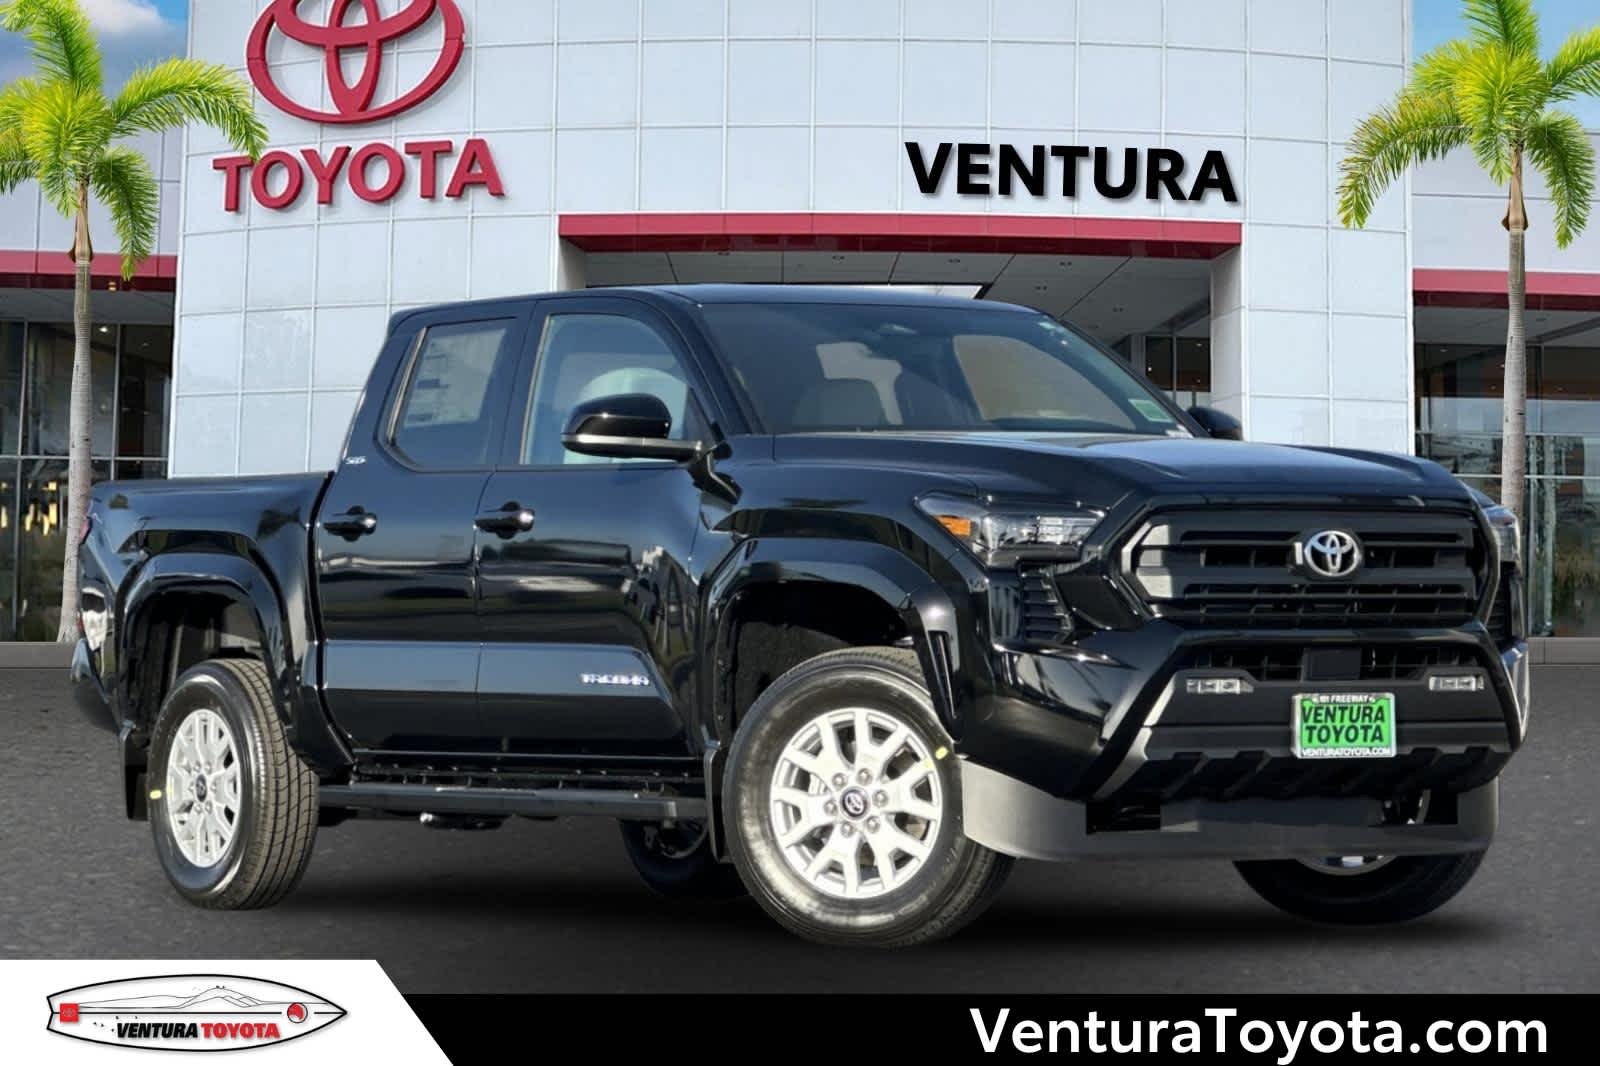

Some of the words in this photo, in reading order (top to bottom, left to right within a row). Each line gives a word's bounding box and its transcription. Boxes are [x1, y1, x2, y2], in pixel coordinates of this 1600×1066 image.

[212, 138, 505, 212] TOYOTA
[904, 141, 1238, 202] VENTURA
[1330, 694, 1369, 703] FREEWAY
[1301, 706, 1385, 723] VENTURA
[1305, 725, 1384, 743] TOYOTA
